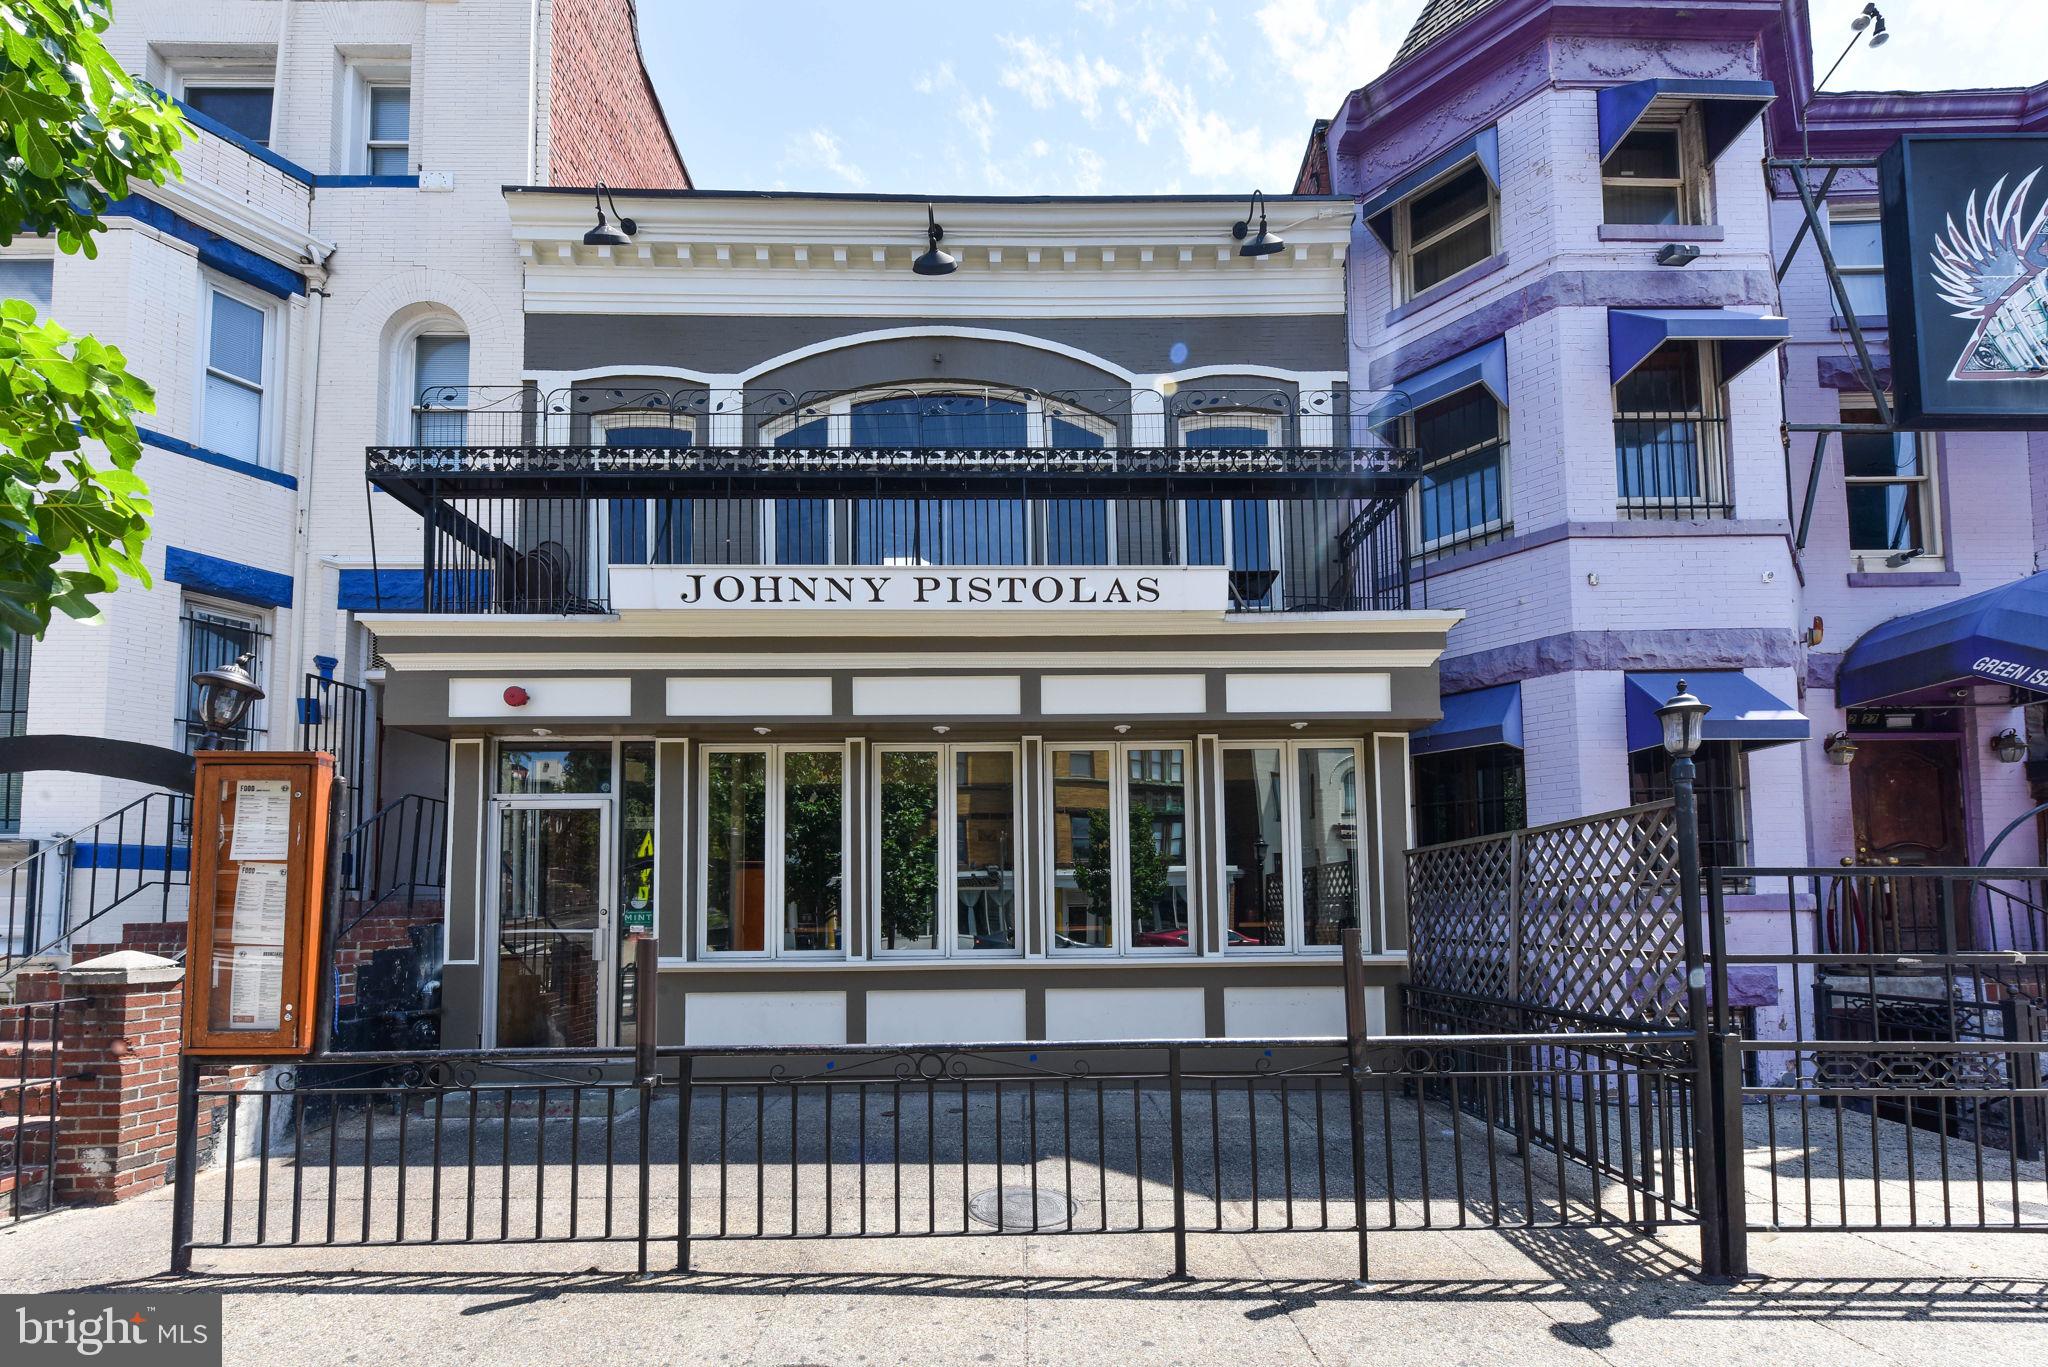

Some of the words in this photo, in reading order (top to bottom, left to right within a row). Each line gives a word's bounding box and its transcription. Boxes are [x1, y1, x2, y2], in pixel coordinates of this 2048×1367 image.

[681, 574, 891, 604] JOHNNY
[914, 576, 1160, 604] PISTOLAS
[1972, 656, 2031, 680] GREEN
